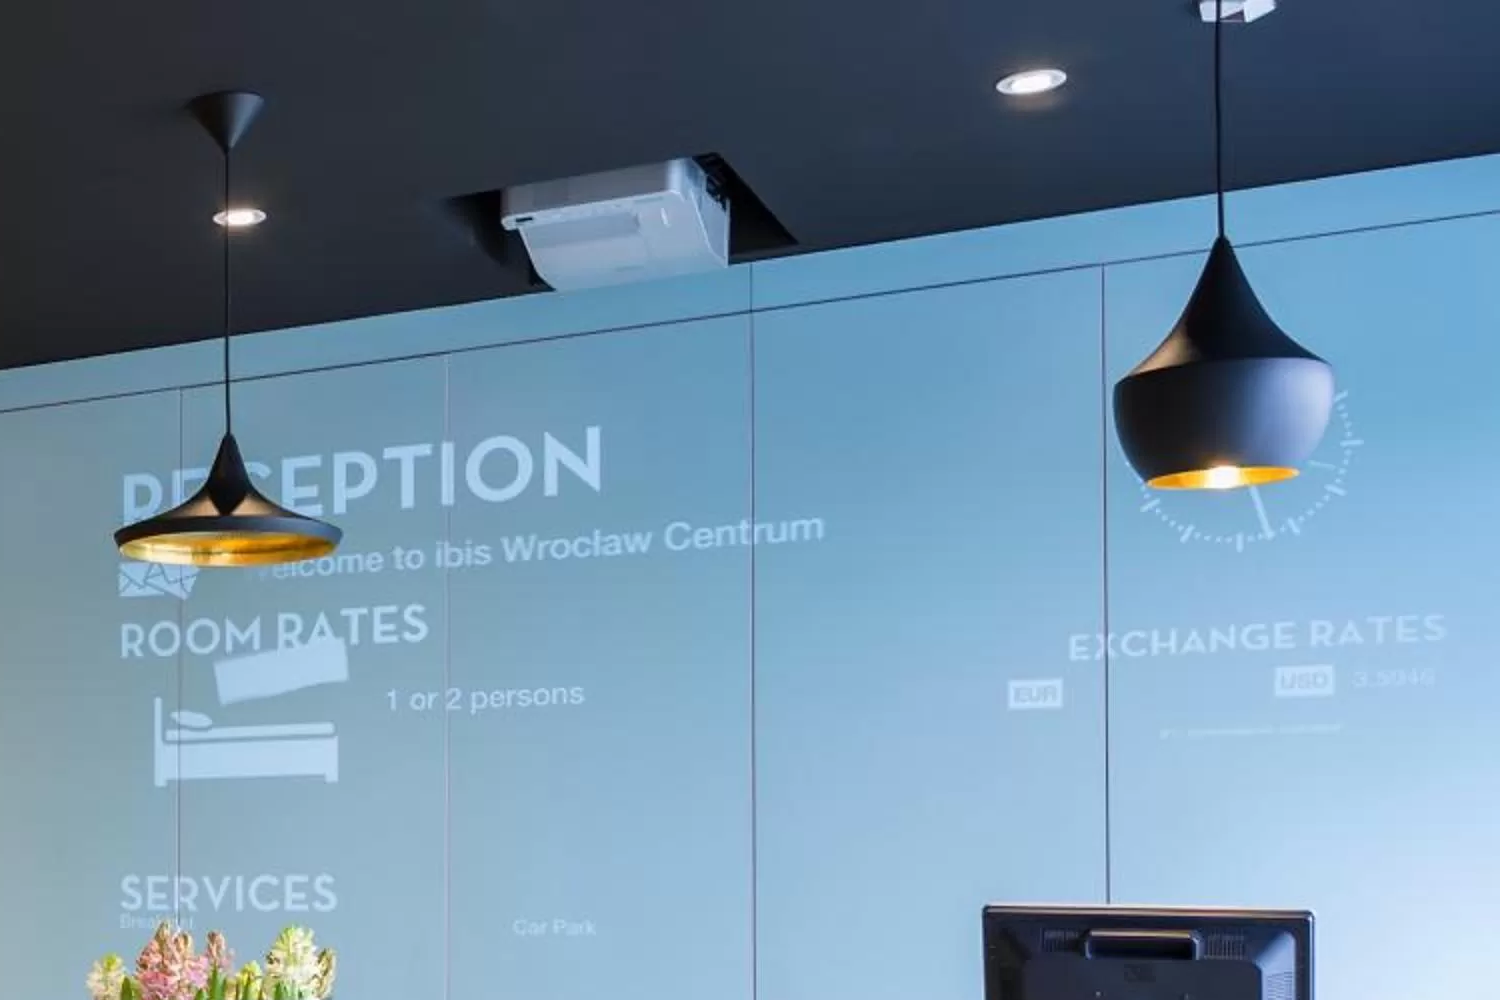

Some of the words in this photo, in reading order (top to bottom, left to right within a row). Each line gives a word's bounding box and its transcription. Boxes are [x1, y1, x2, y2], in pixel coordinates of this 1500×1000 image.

[246, 551, 385, 580] elcome
[394, 547, 426, 571] to
[435, 540, 493, 569] ibis
[663, 516, 826, 552] Centrum
[119, 614, 261, 659] ROOM
[277, 603, 430, 654] RATES
[1067, 620, 1297, 662] EXCHANGE
[1309, 613, 1449, 648] RATES
[387, 688, 398, 711] 1
[408, 690, 440, 712] or
[445, 686, 462, 711] 2
[470, 684, 586, 715] persons
[120, 872, 340, 914] SERVICES
[553, 918, 597, 937] Park
